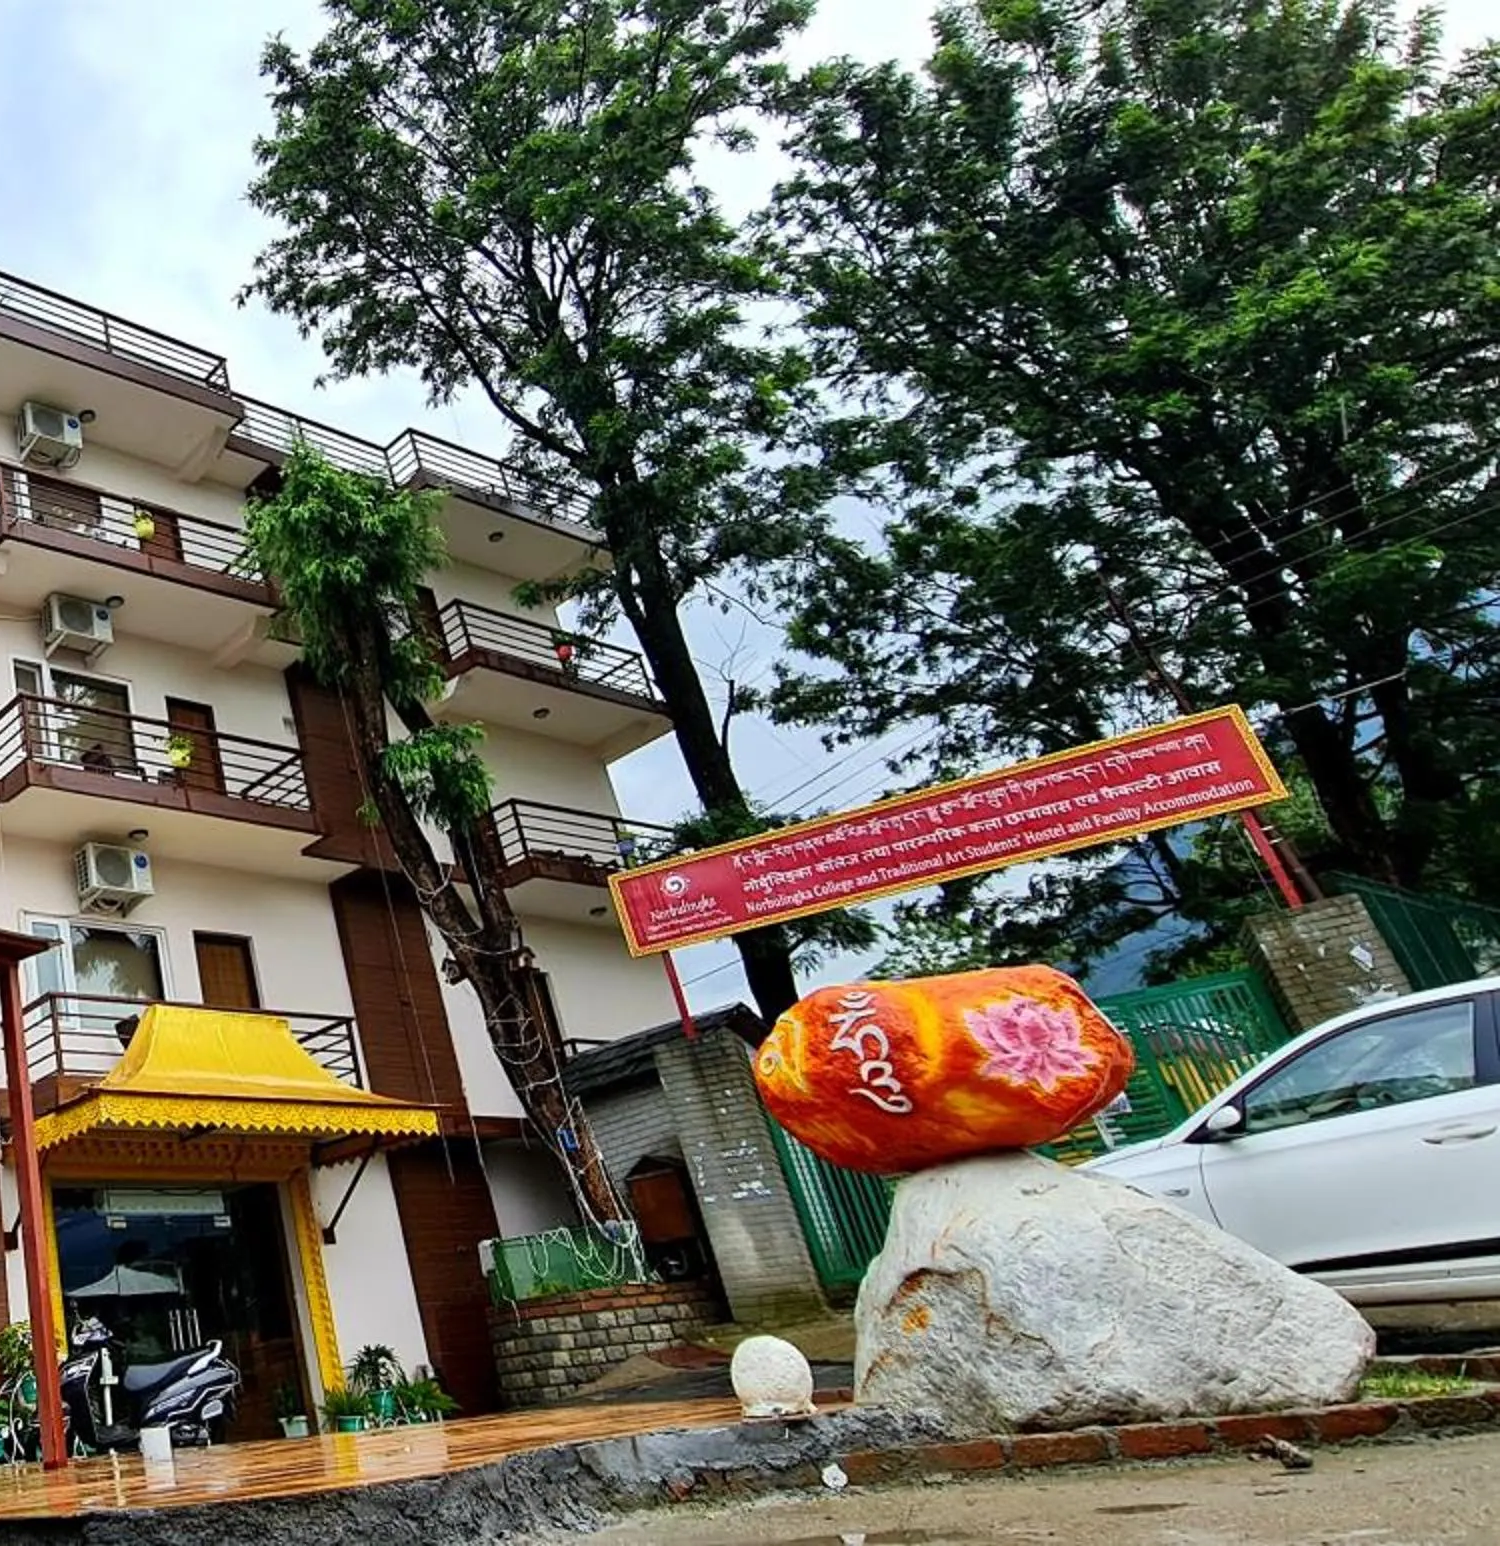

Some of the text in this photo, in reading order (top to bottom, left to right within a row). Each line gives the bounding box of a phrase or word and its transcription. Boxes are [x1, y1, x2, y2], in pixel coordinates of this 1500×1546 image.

[746, 889, 812, 914] Norbulingka
[813, 878, 855, 897] College
[855, 871, 878, 885] and
[879, 855, 942, 879] Traditional
[944, 849, 965, 863] Art
[1025, 824, 1065, 843] Hostel
[1068, 818, 1092, 833] and
[1094, 806, 1143, 829] Faculty
[1145, 779, 1254, 814] Accommodation
[862, 846, 891, 862] तथा
[892, 825, 965, 853] पारम्परिक
[968, 818, 1003, 834] कला
[1167, 760, 1221, 784] आवास
